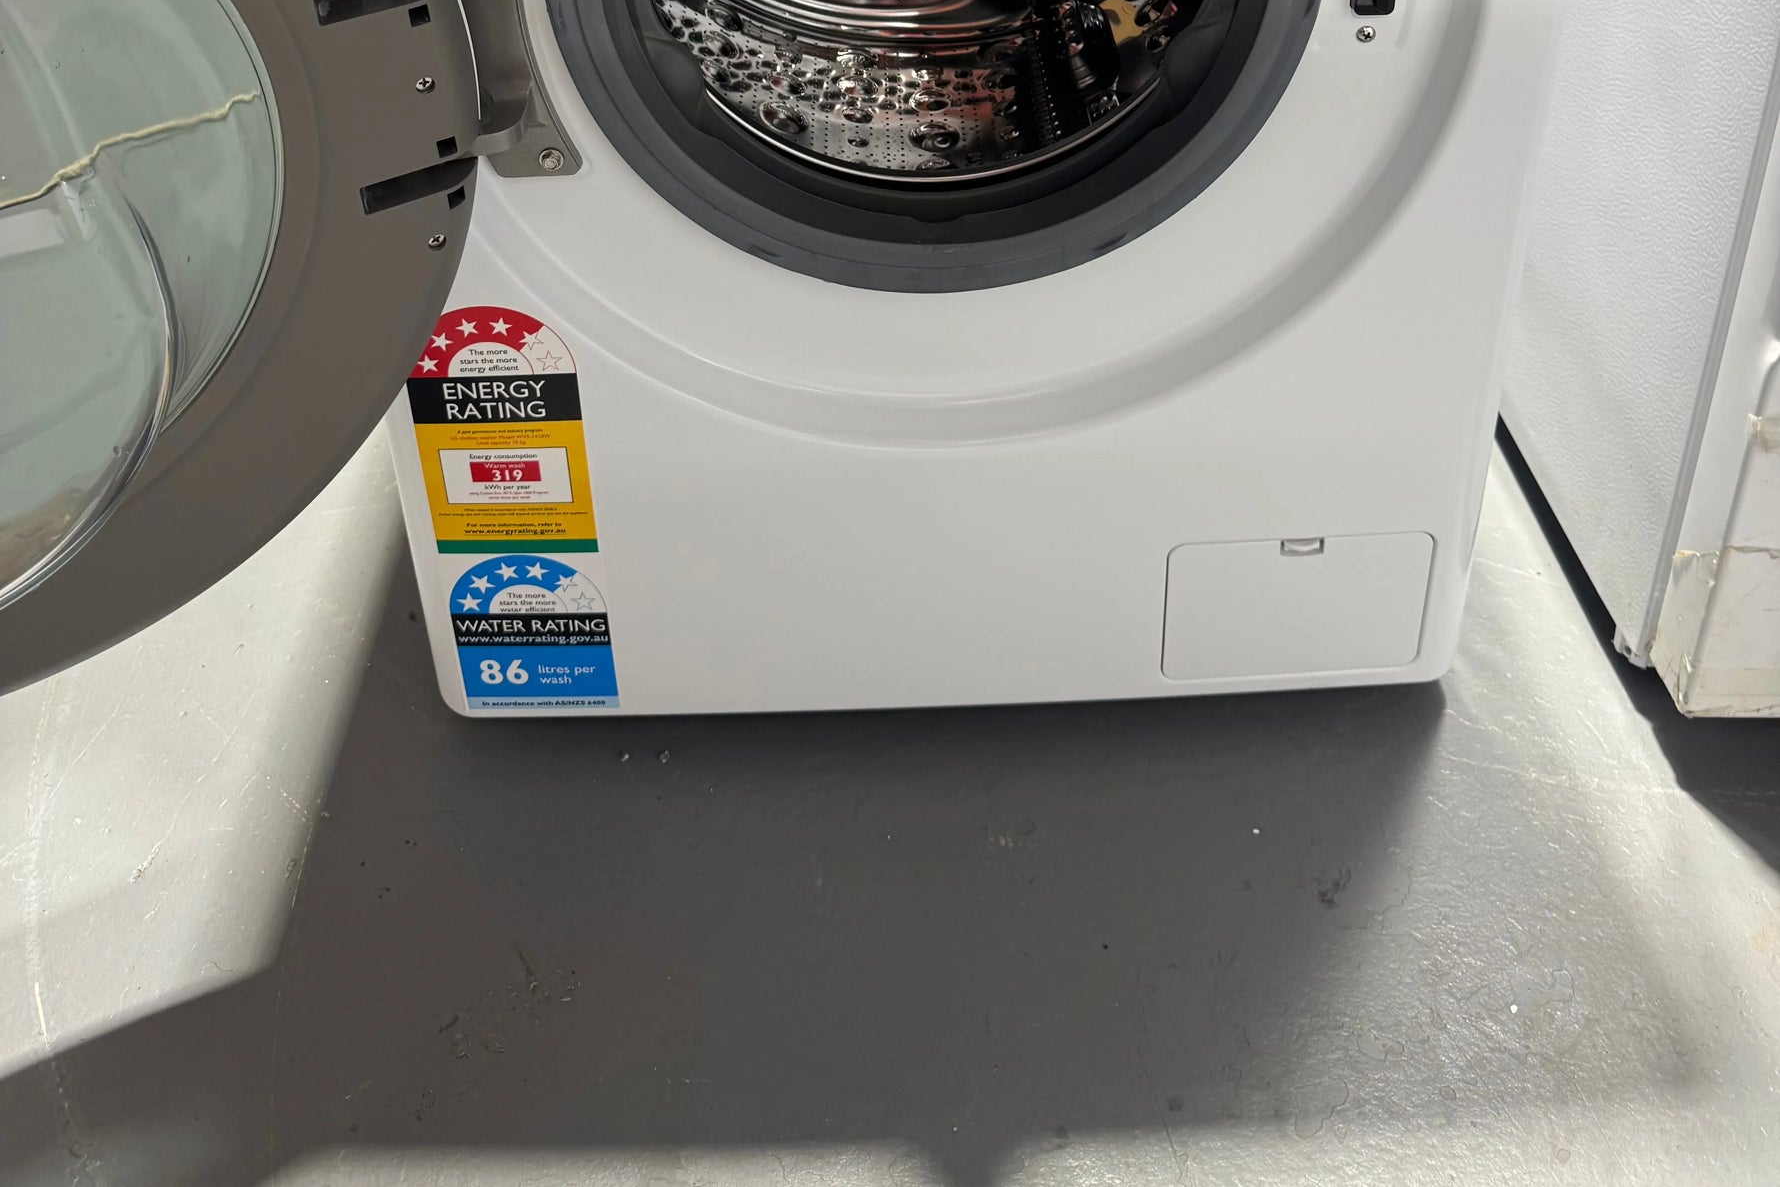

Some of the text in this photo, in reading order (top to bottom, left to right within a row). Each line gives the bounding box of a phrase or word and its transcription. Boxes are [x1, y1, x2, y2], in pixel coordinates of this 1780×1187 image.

[442, 380, 545, 400] ENERGY
[446, 400, 547, 420] RATING
[491, 469, 523, 481] 319
[464, 527, 566, 535] www.energyrating.gov.au
[456, 618, 606, 633] WATER RATING
[457, 633, 609, 644] www.waterrating.gov.au
[479, 659, 530, 685] 86
[538, 664, 596, 676] litres per
[540, 675, 572, 684] wash
